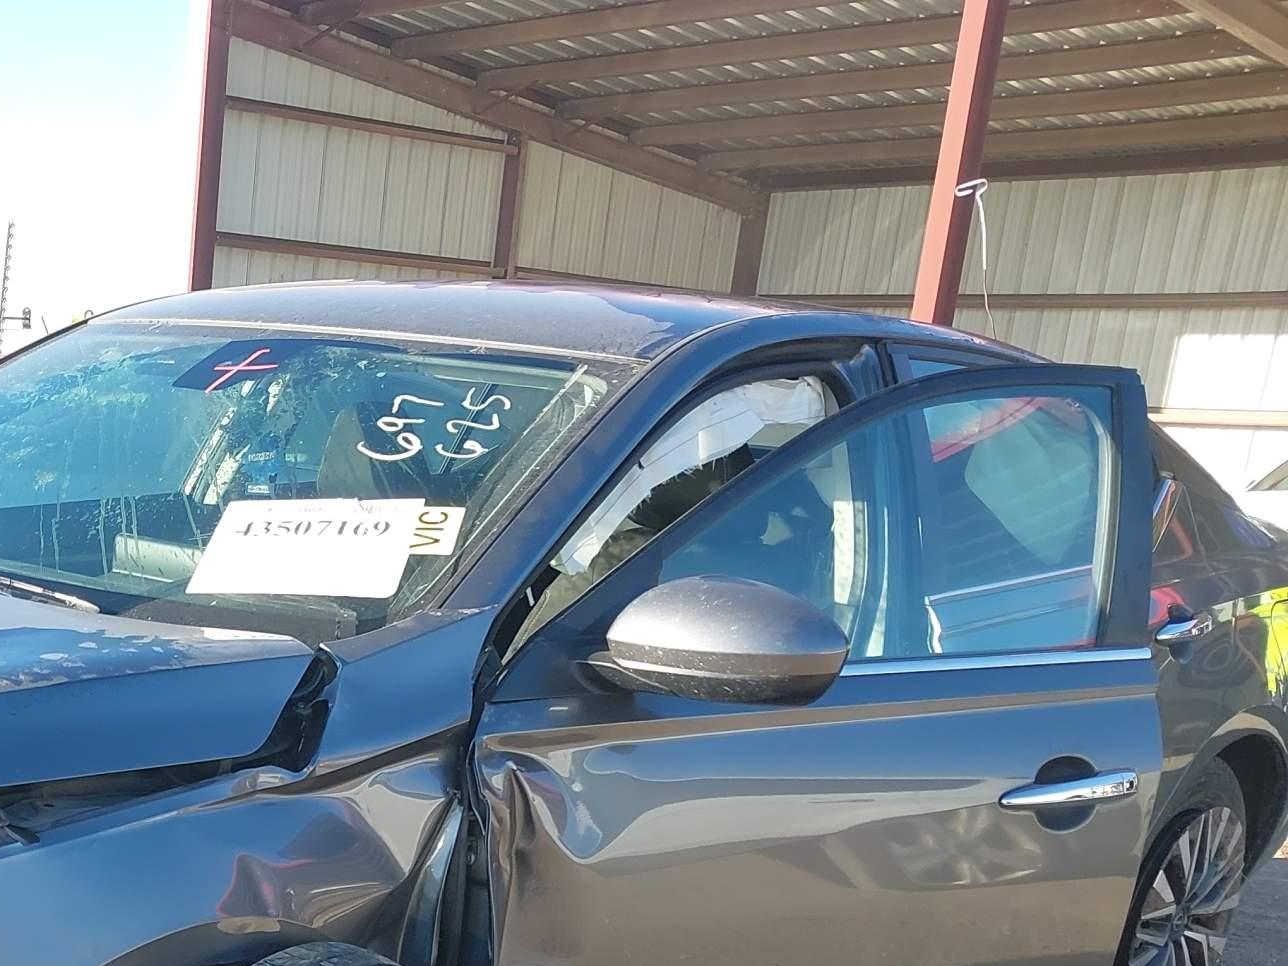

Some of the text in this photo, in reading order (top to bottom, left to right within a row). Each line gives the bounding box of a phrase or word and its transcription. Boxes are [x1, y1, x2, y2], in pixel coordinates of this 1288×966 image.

[357, 394, 444, 461] 697
[435, 387, 511, 459] 625
[235, 520, 391, 537] 43507169
[409, 511, 449, 549] VIC
